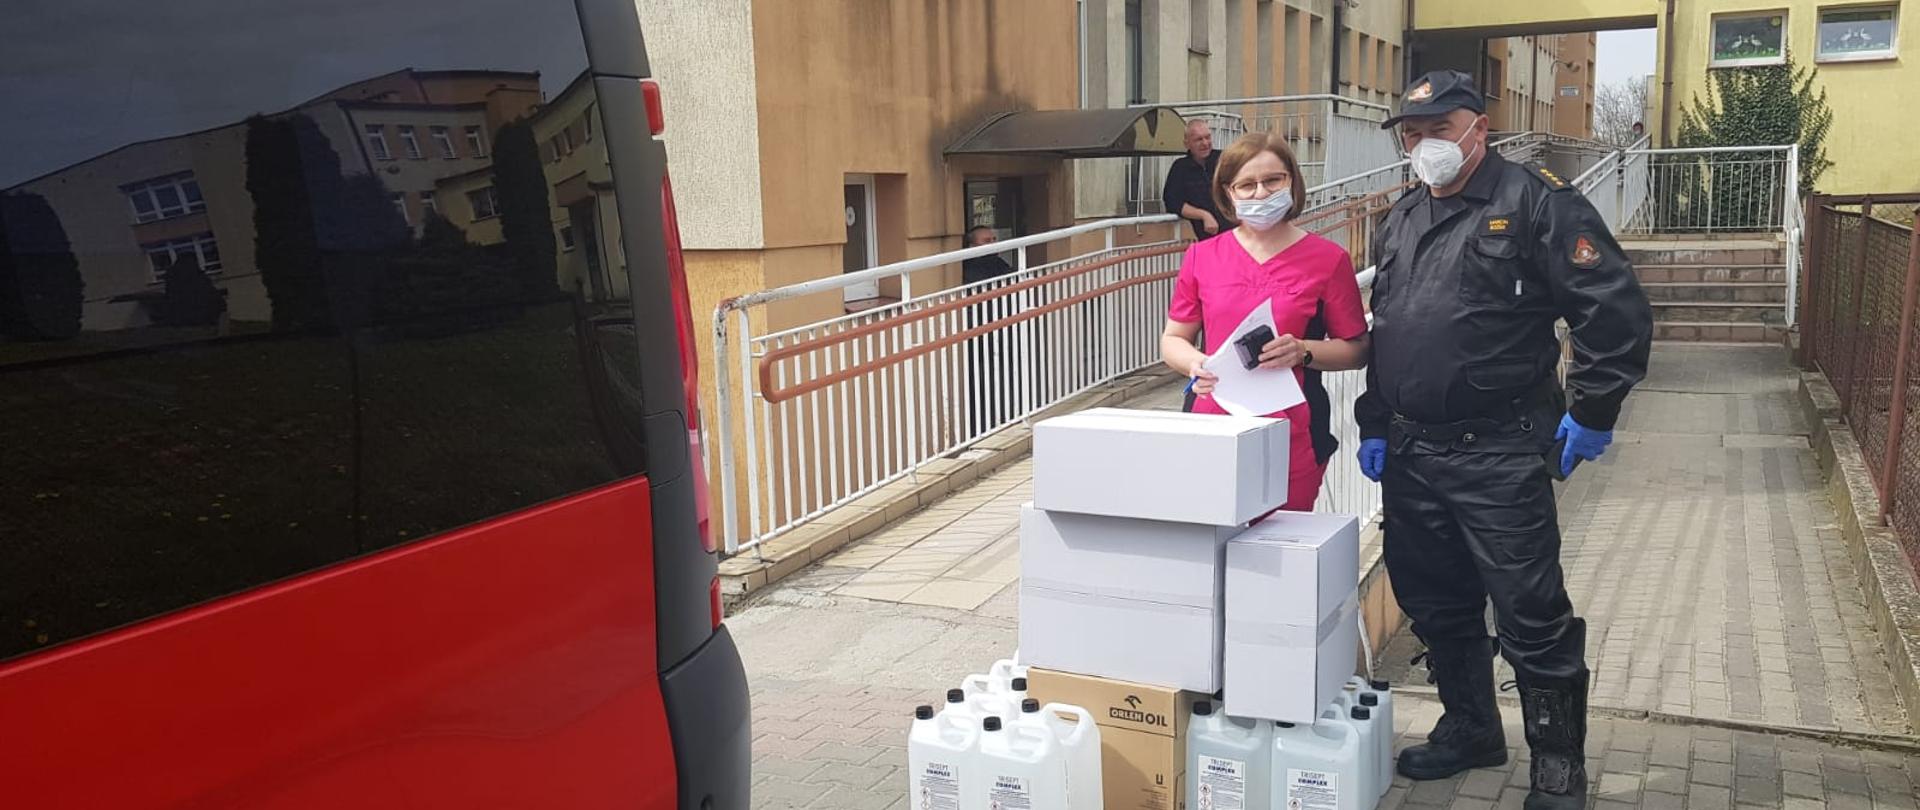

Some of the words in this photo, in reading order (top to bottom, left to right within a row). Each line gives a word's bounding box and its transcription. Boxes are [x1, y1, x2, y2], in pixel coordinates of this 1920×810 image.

[1110, 708, 1143, 722] ORLEN
[1145, 713, 1168, 727] OIL
[926, 768, 951, 777] COMPLEX
[1207, 765, 1235, 774] COMPLEX
[995, 781, 1021, 790] COMPLEX
[1298, 778, 1328, 786] COMPLEX
